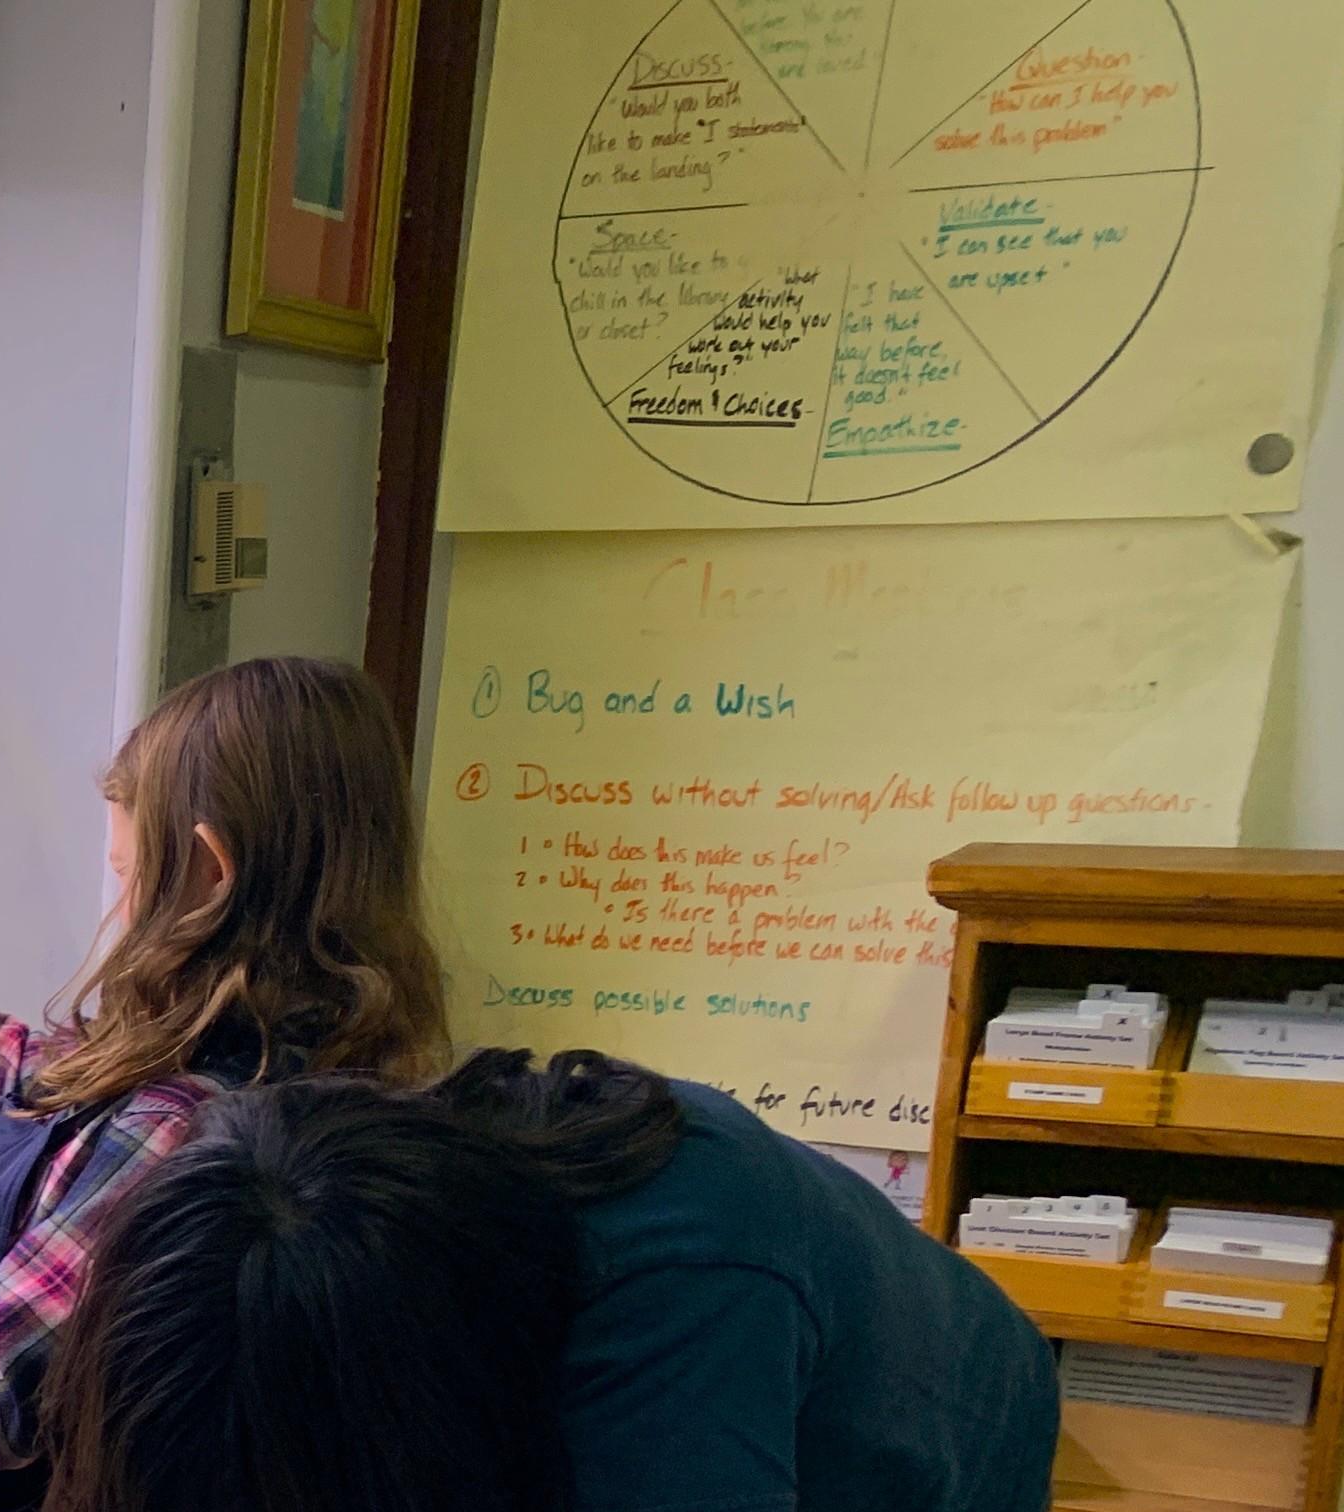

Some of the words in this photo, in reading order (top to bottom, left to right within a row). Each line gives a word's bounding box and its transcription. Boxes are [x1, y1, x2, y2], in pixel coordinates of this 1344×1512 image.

[673, 97, 698, 128] you
[705, 82, 742, 109] both
[1029, 92, 1062, 111] can
[1066, 83, 1087, 109] I
[1092, 80, 1137, 109] help
[1141, 81, 1180, 108] you
[586, 132, 617, 155] like
[627, 130, 643, 151] to
[650, 130, 692, 150] make
[989, 121, 1027, 147] this
[580, 170, 602, 188] on
[611, 158, 641, 184] the
[958, 238, 989, 256] can
[996, 233, 1034, 255] see
[1043, 226, 1084, 248] that
[1093, 226, 1130, 250] you
[632, 263, 661, 286] you
[668, 252, 701, 276] like
[947, 271, 980, 289] are
[637, 285, 666, 309] the
[737, 288, 805, 313] activity
[759, 312, 792, 337] help
[800, 312, 832, 337] you
[884, 311, 922, 332] that
[687, 335, 722, 354] work
[728, 336, 755, 353] out
[760, 336, 801, 360] your
[918, 360, 962, 388] feel
[627, 384, 703, 416] Freedom
[526, 669, 586, 734] Bug
[603, 678, 661, 715] and
[672, 691, 693, 715] a
[715, 681, 796, 719] Wish
[513, 763, 634, 806] Discuss
[651, 776, 762, 808] without
[946, 775, 1016, 824] follow
[1025, 789, 1057, 826] up
[563, 830, 601, 859] How
[606, 834, 648, 862] does
[653, 836, 689, 865] this
[695, 843, 743, 868] make
[751, 849, 777, 867] us
[558, 865, 602, 903] Why
[610, 867, 648, 893] does
[660, 870, 695, 894] this
[622, 899, 649, 924] Is
[660, 897, 716, 924] there
[728, 909, 742, 926] a
[753, 903, 838, 942] problem
[847, 905, 894, 933] with
[904, 908, 938, 934] the
[543, 921, 586, 948] What
[590, 923, 611, 951] do
[619, 932, 643, 951] we
[650, 924, 697, 954] need
[705, 928, 768, 970] before
[775, 940, 804, 962] we
[808, 944, 845, 962] can
[853, 938, 909, 966] solve
[481, 973, 575, 1008] Discuss
[593, 987, 687, 1017] possible
[705, 993, 811, 1023] solutions
[753, 1081, 788, 1115] for
[799, 1085, 876, 1128] future
